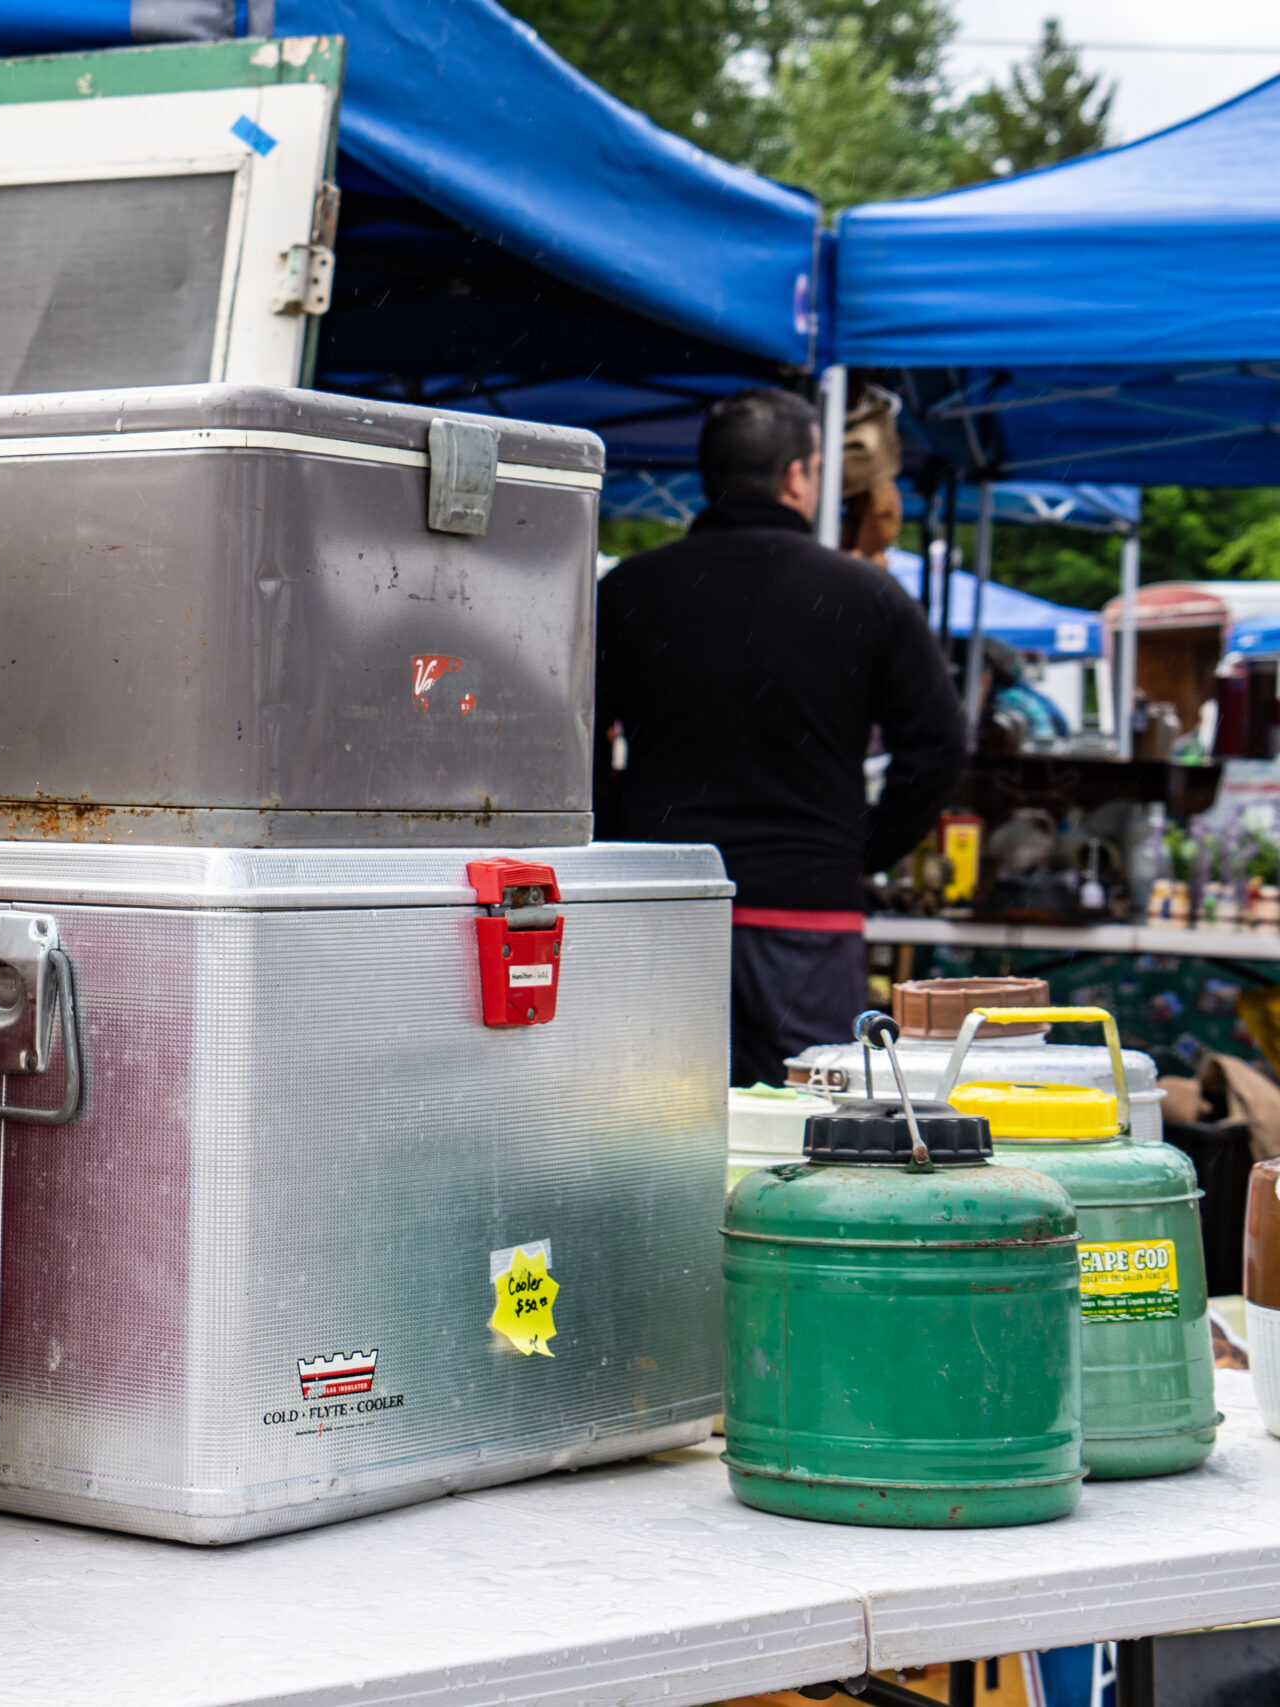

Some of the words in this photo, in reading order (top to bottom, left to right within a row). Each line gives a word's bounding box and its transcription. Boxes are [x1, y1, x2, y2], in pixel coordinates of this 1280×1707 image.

[1078, 1250, 1129, 1273] CAPE
[1133, 1247, 1169, 1271] COD
[508, 1272, 543, 1295] Cooler
[338, 1382, 368, 1394] INSULATED
[263, 1409, 299, 1425] COLD
[309, 1403, 348, 1420] FLYTE
[357, 1394, 405, 1414] COOLER
